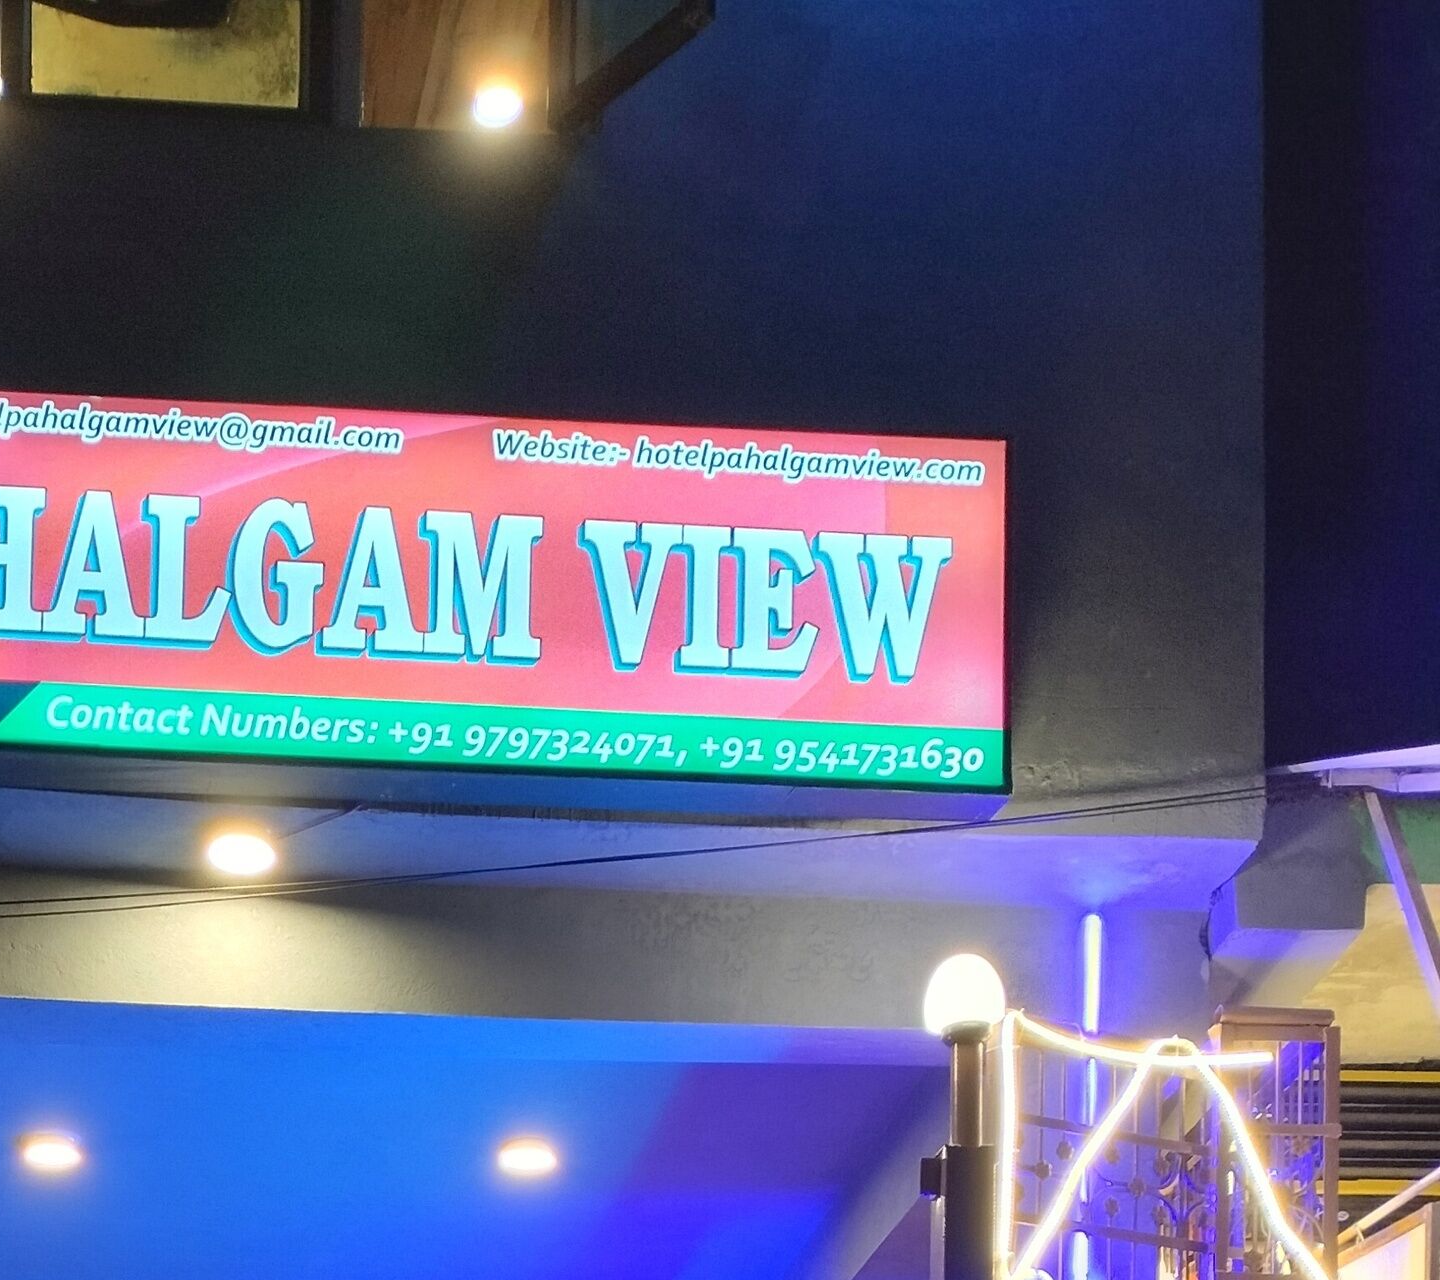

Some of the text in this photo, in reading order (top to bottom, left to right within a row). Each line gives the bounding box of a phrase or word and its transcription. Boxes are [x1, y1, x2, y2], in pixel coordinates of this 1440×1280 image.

[634, 438, 984, 484] hotelpahalgamview.com
[578, 519, 953, 686] VIEW
[46, 694, 986, 779] Contact Numbers: +91 9797324071, +91 9541731630
